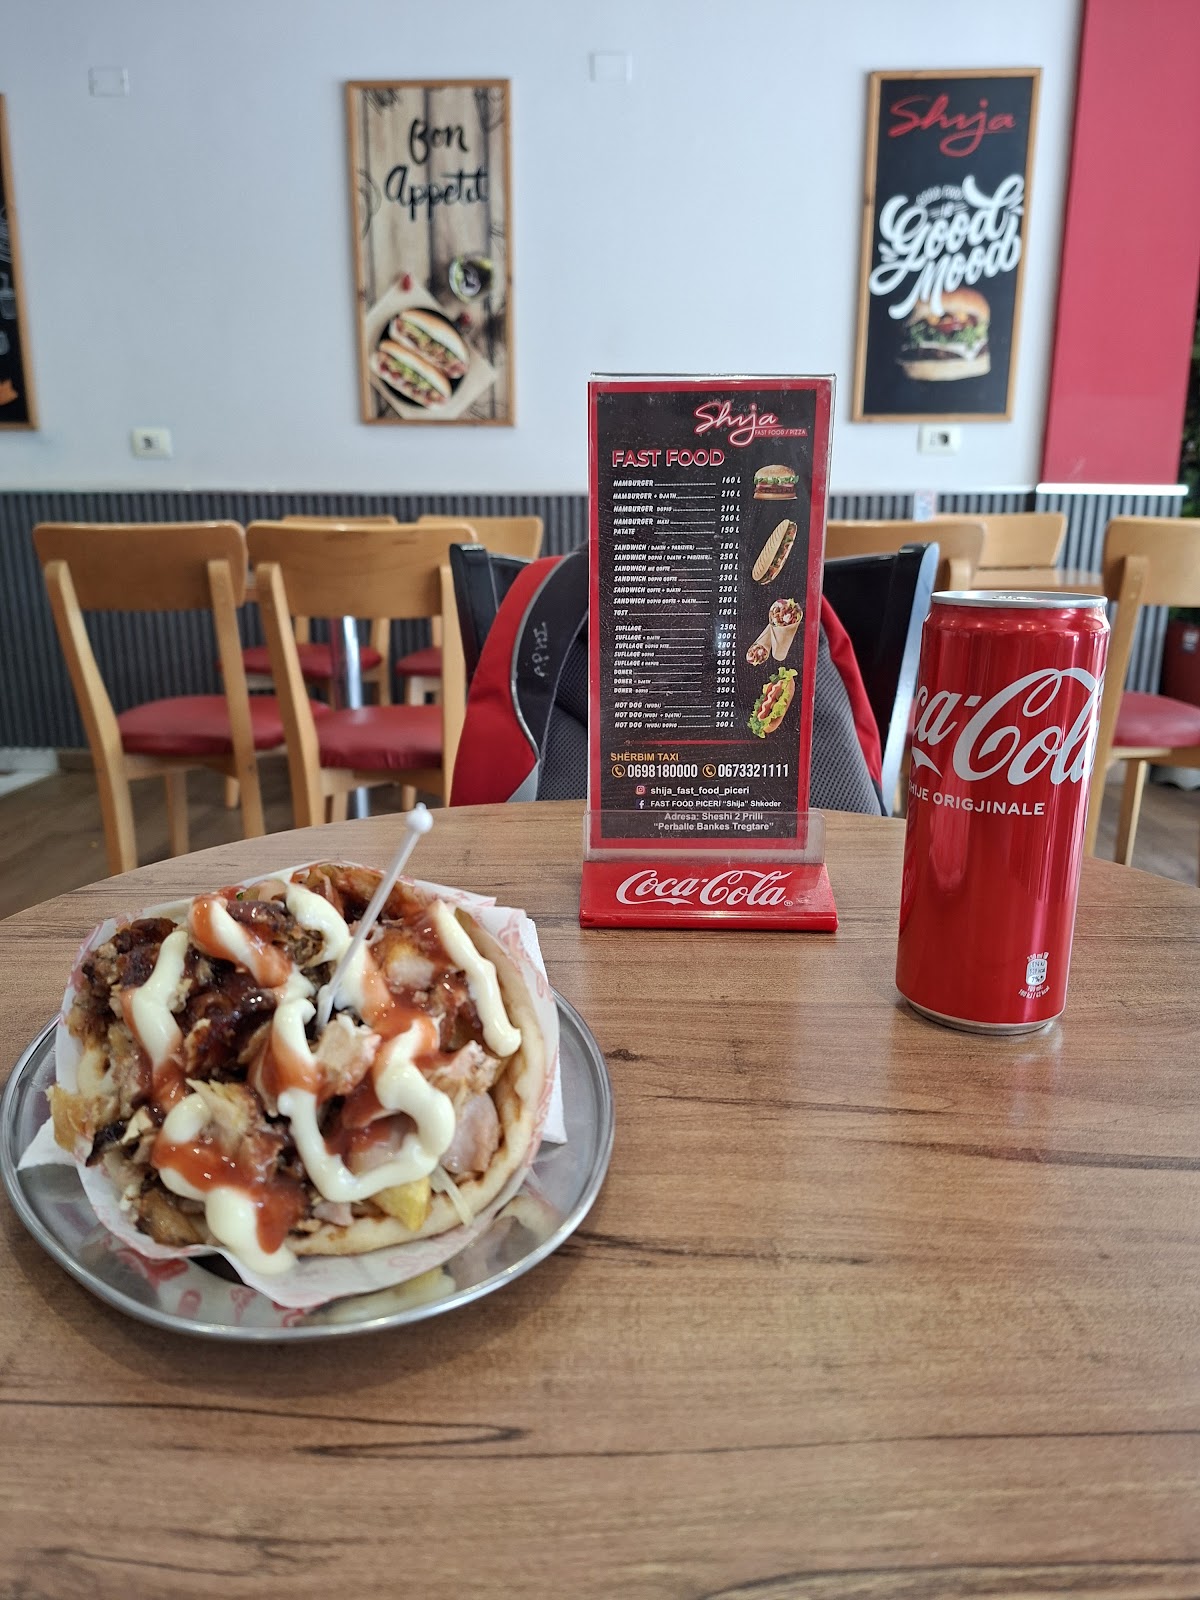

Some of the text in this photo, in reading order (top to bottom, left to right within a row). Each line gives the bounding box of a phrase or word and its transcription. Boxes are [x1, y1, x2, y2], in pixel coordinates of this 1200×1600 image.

[408, 118, 469, 166] Bon
[384, 163, 489, 221] Appetit
[868, 174, 1025, 296] Good
[887, 213, 1022, 320] Mood
[768, 428, 784, 436] FOOD
[790, 427, 806, 435] PIZZA
[612, 448, 725, 467] FAST FOOD
[610, 752, 679, 762] SHËRBIM TAXI
[627, 763, 789, 778] 0698180000 0673321111
[651, 787, 750, 796] shija_fast_food_piceri
[932, 792, 1046, 816] ORIGJINALE
[615, 869, 793, 906] Coca-Cola
